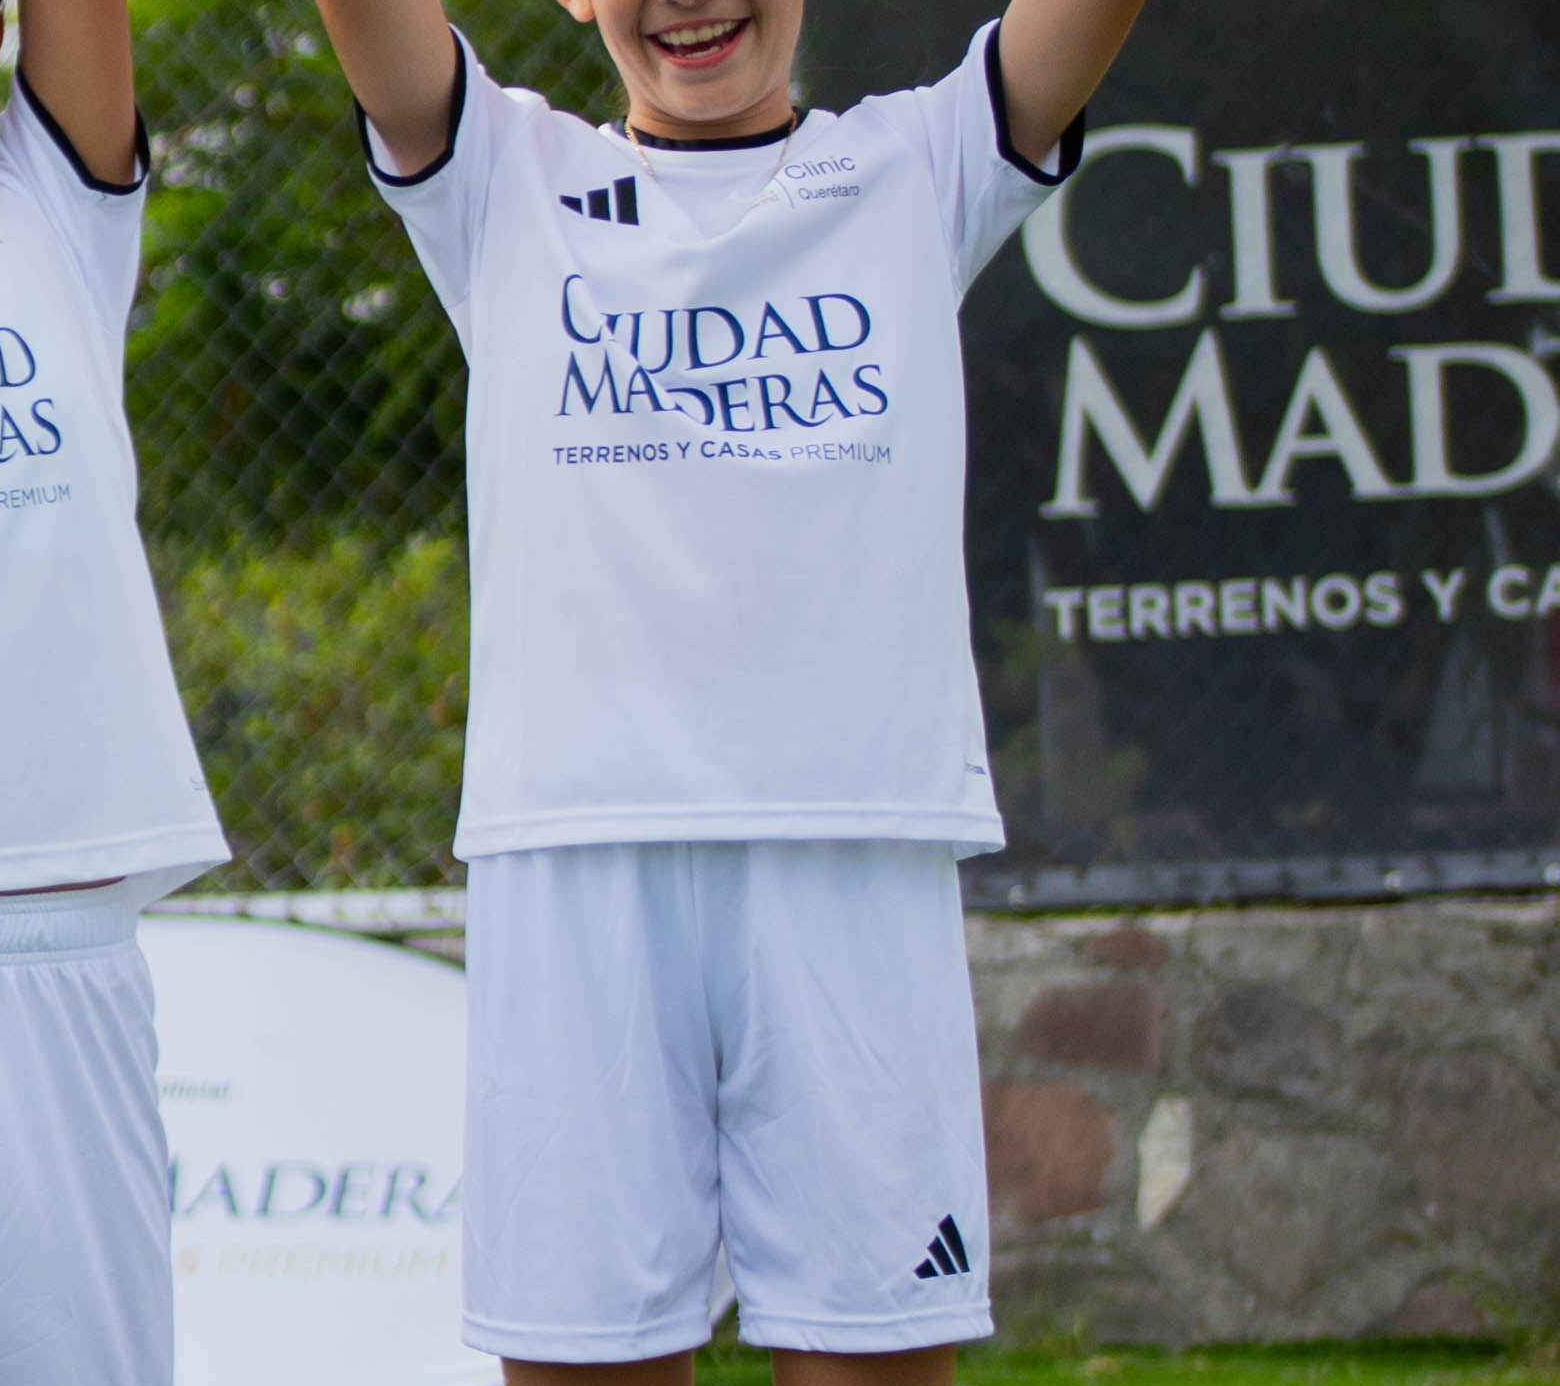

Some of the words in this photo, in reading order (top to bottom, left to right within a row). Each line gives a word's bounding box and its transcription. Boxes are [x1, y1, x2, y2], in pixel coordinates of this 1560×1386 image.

[784, 156, 856, 180] Clinic
[1038, 327, 1560, 519] MAD
[552, 442, 670, 465] TERRENOS
[676, 440, 691, 460] Y
[700, 440, 782, 461] CASAS
[790, 443, 892, 466] PREMIUM
[1043, 569, 1404, 643] TERRENOS
[1421, 569, 1467, 623] Y
